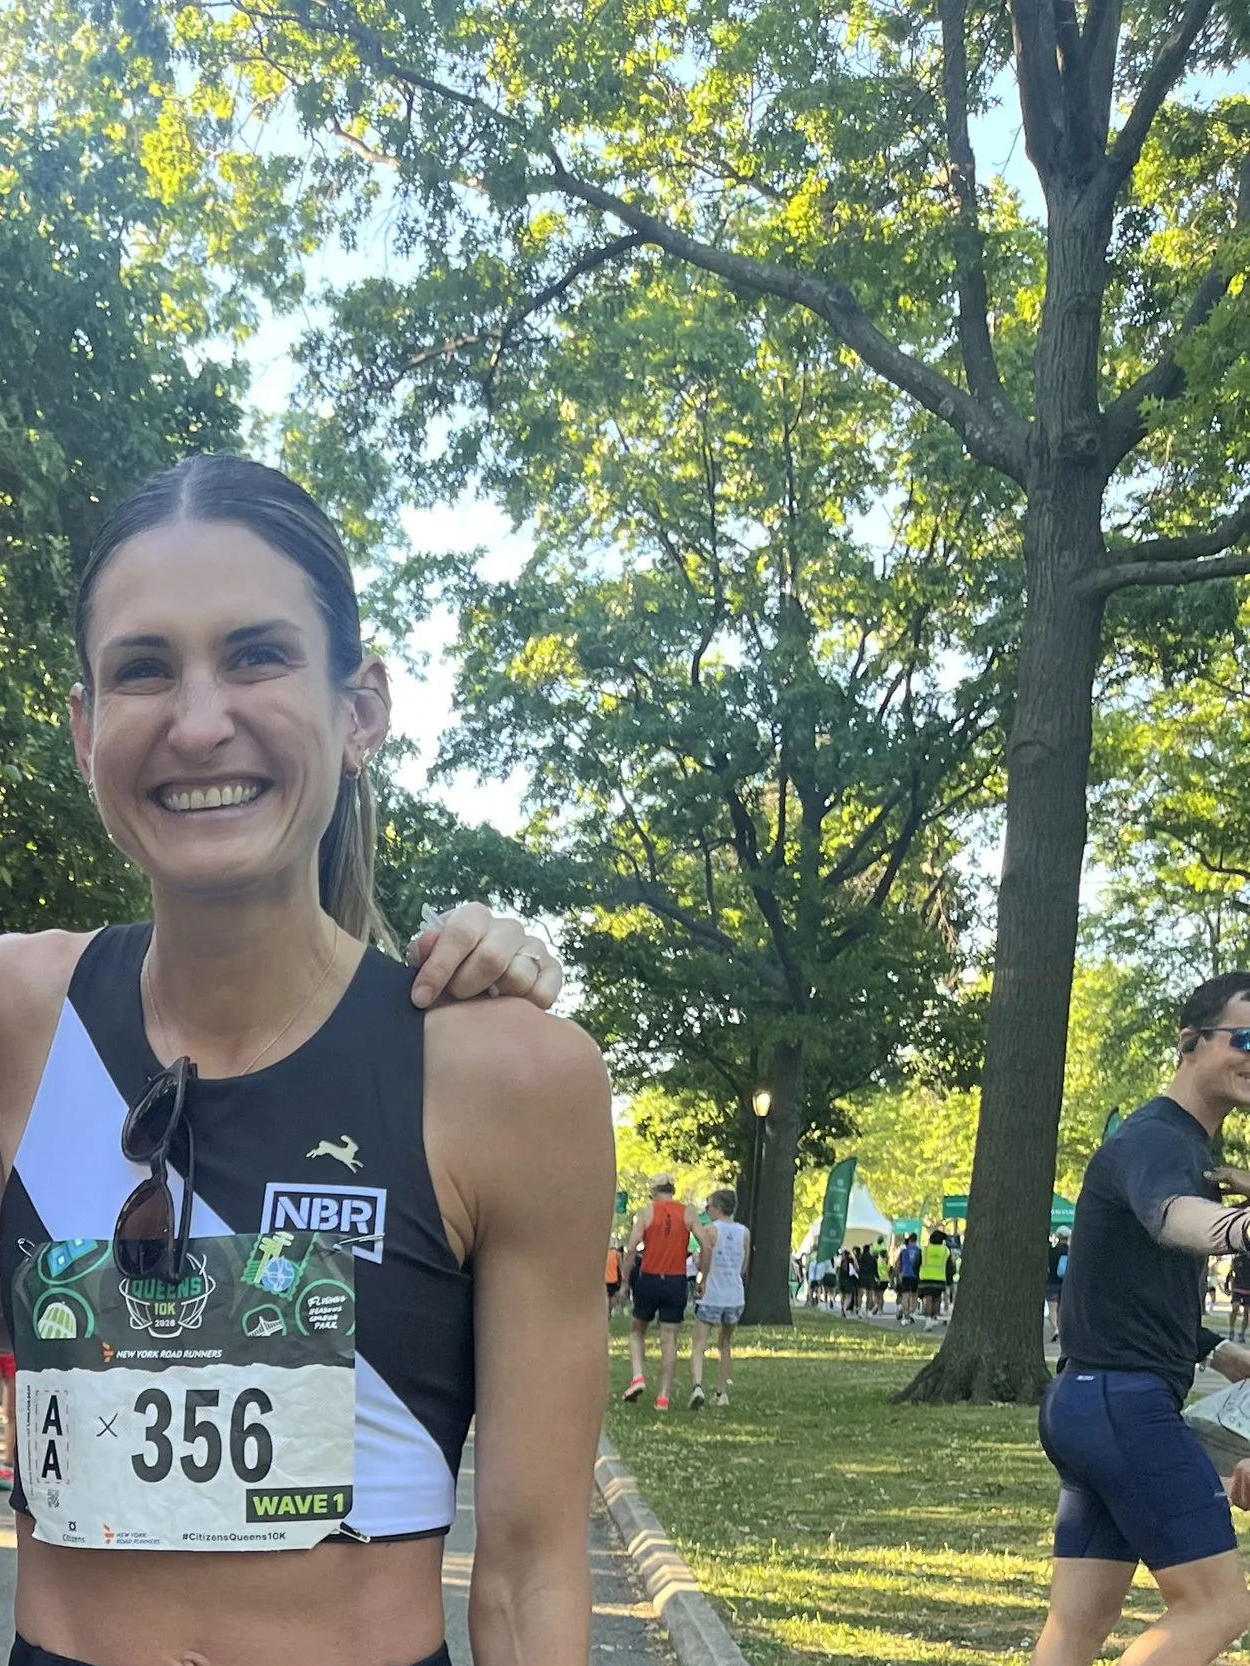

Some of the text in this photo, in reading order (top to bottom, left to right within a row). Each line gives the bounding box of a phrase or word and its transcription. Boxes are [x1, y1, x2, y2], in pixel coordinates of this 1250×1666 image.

[275, 1196, 372, 1234] NBR
[154, 1302, 176, 1315] 10K
[116, 1349, 223, 1359] NEW YORK ROAD RUNNERS
[131, 1388, 273, 1483] 356
[253, 1493, 344, 1516] WAVE 1
[182, 1532, 286, 1542] #CitizensQueens10K
